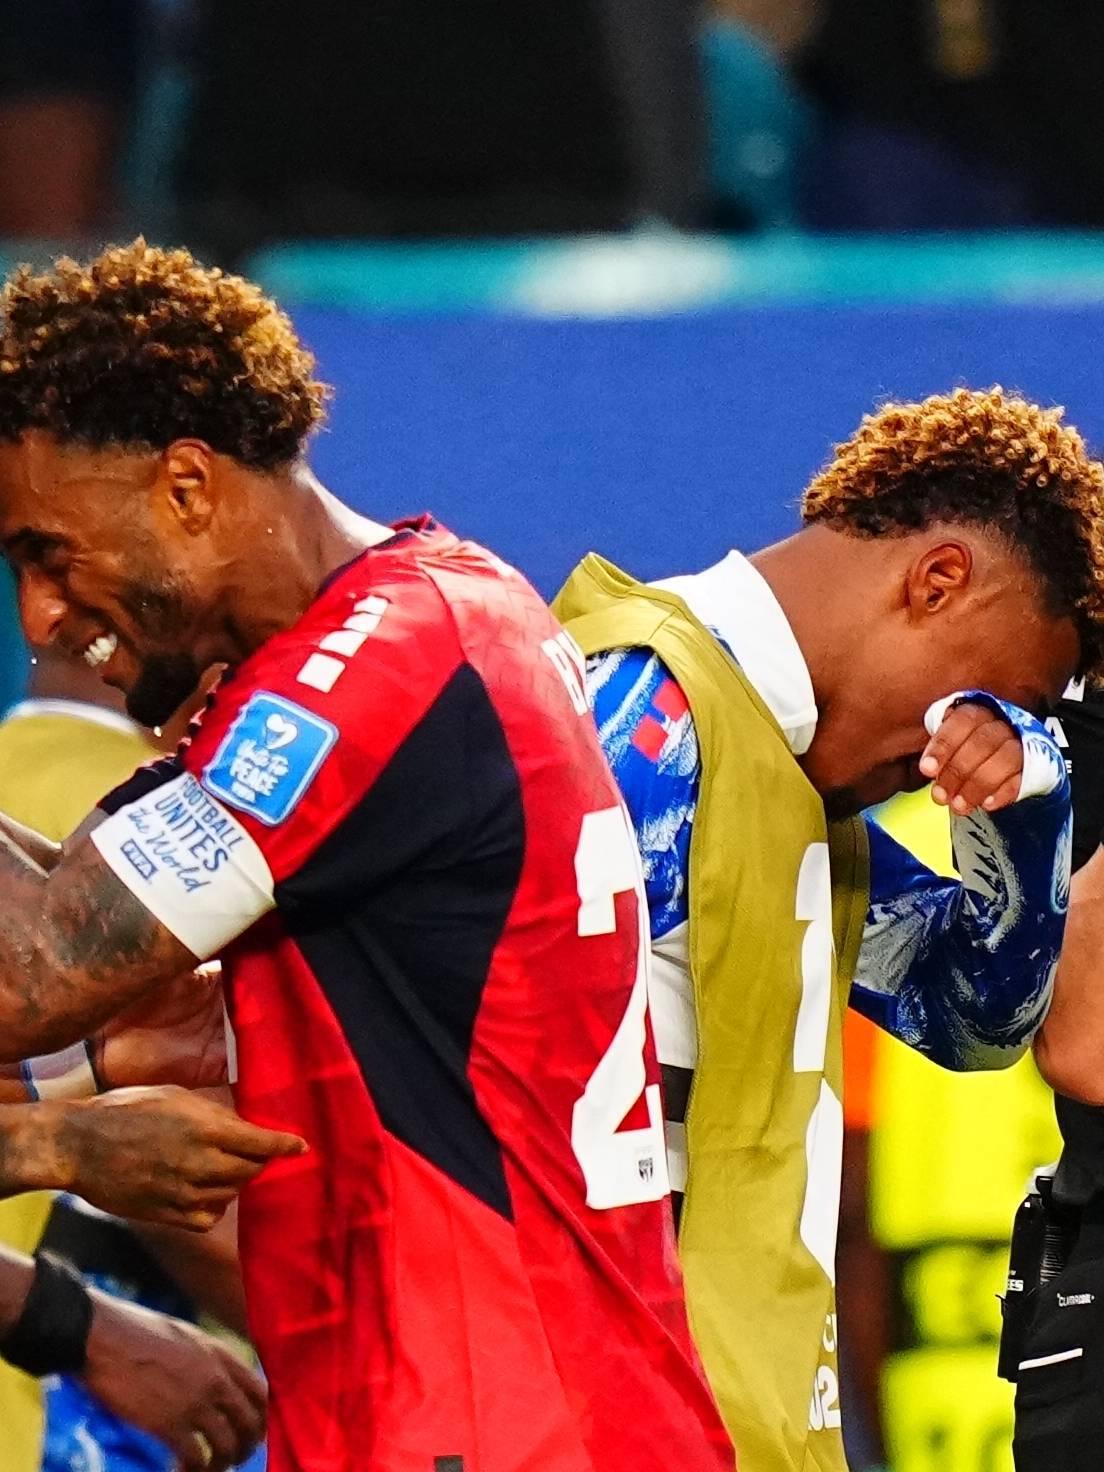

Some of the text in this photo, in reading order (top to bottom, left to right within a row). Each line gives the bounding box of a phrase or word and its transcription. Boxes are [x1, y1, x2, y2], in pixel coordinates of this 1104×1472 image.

[154, 791, 229, 873] UNITES
[180, 775, 244, 852] FOOTBALL
[146, 830, 212, 894] World
